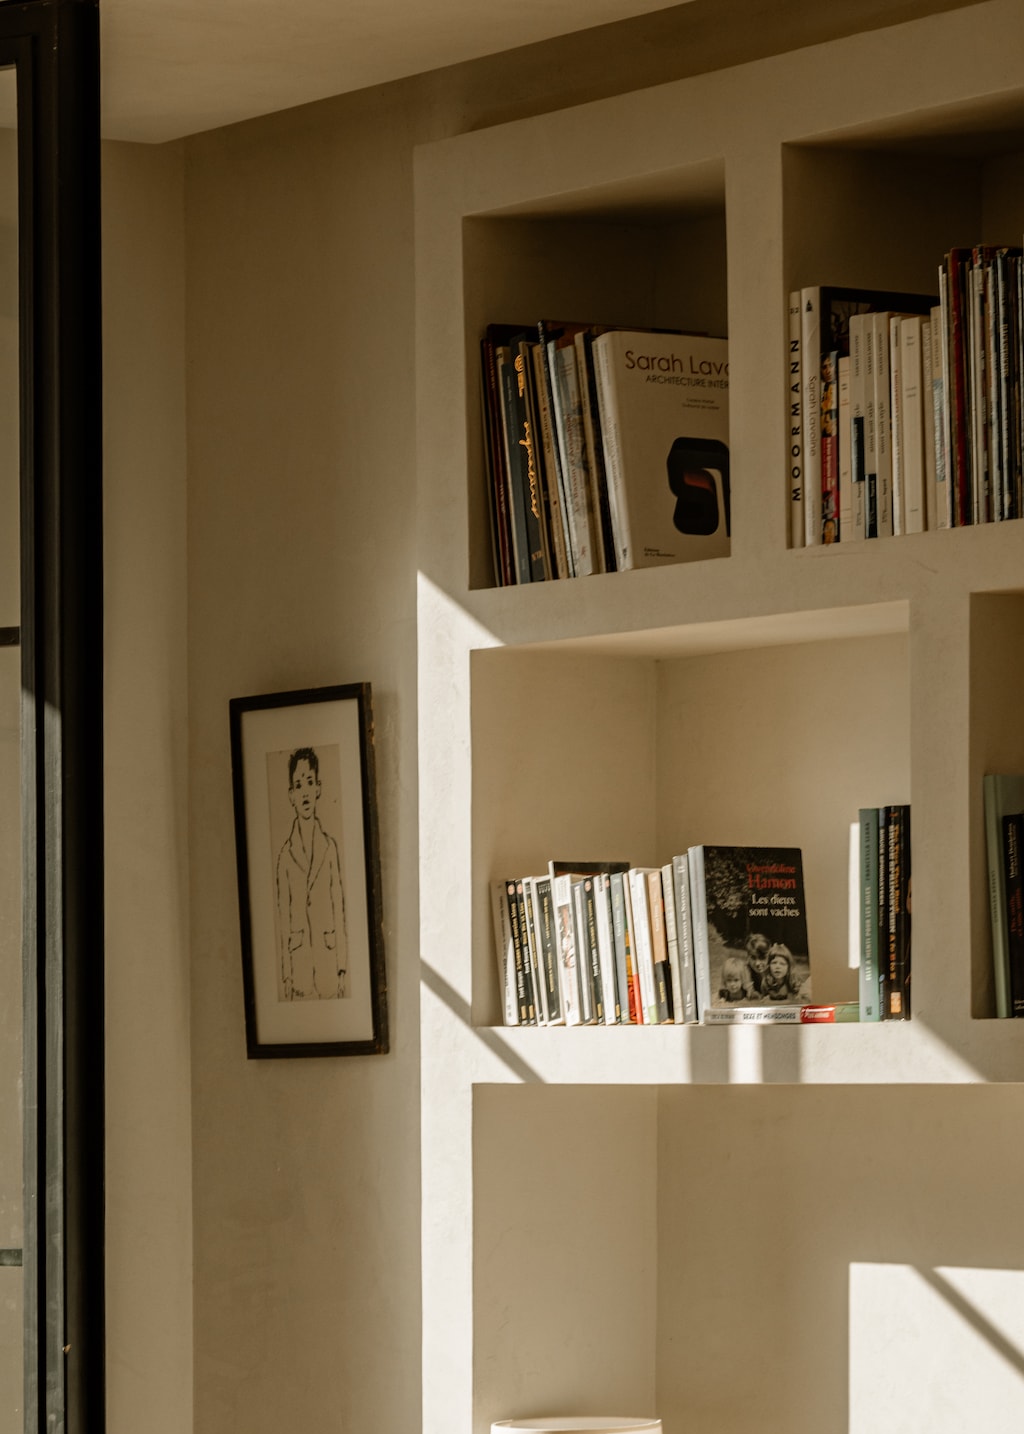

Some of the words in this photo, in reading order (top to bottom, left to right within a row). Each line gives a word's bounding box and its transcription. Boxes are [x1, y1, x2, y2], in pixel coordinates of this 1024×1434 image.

[624, 350, 683, 374] Sarah
[645, 375, 706, 388] ARCHITECTURE
[808, 376, 817, 409] Sarah
[790, 340, 801, 501] MOORMANN
[808, 411, 818, 456] Lavoine
[746, 863, 796, 874] Gwendoline
[748, 874, 797, 889] Hamon
[751, 894, 769, 905] Les
[770, 893, 796, 905] dieux
[748, 907, 768, 917] sont
[770, 906, 800, 917] vaches
